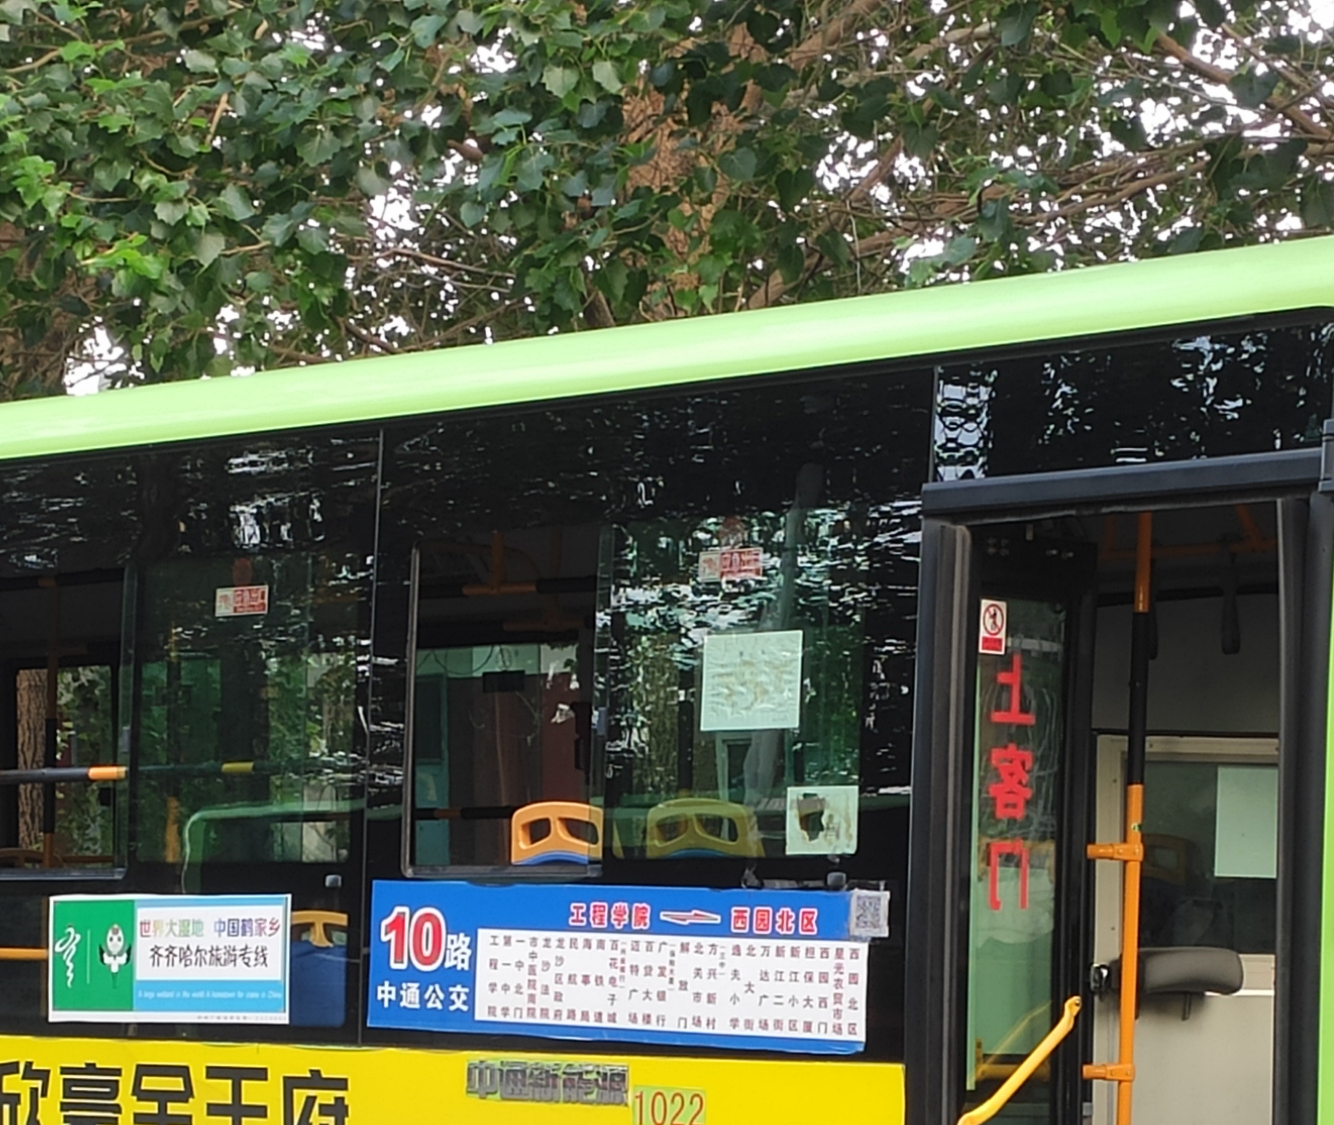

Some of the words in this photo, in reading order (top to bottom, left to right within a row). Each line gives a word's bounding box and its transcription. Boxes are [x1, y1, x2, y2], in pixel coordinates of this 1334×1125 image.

[139, 918, 204, 938] 世界大湿地
[214, 917, 281, 938] 中国鹤家乡
[569, 903, 651, 930] 工程学院
[731, 907, 818, 933] 西园北区
[381, 906, 472, 972] 10路
[149, 944, 269, 968] 齐齐哈尔旅游专线
[487, 935, 499, 1018] 工程学院
[758, 945, 771, 1031] 万达广场
[377, 981, 470, 1012] 中通公交
